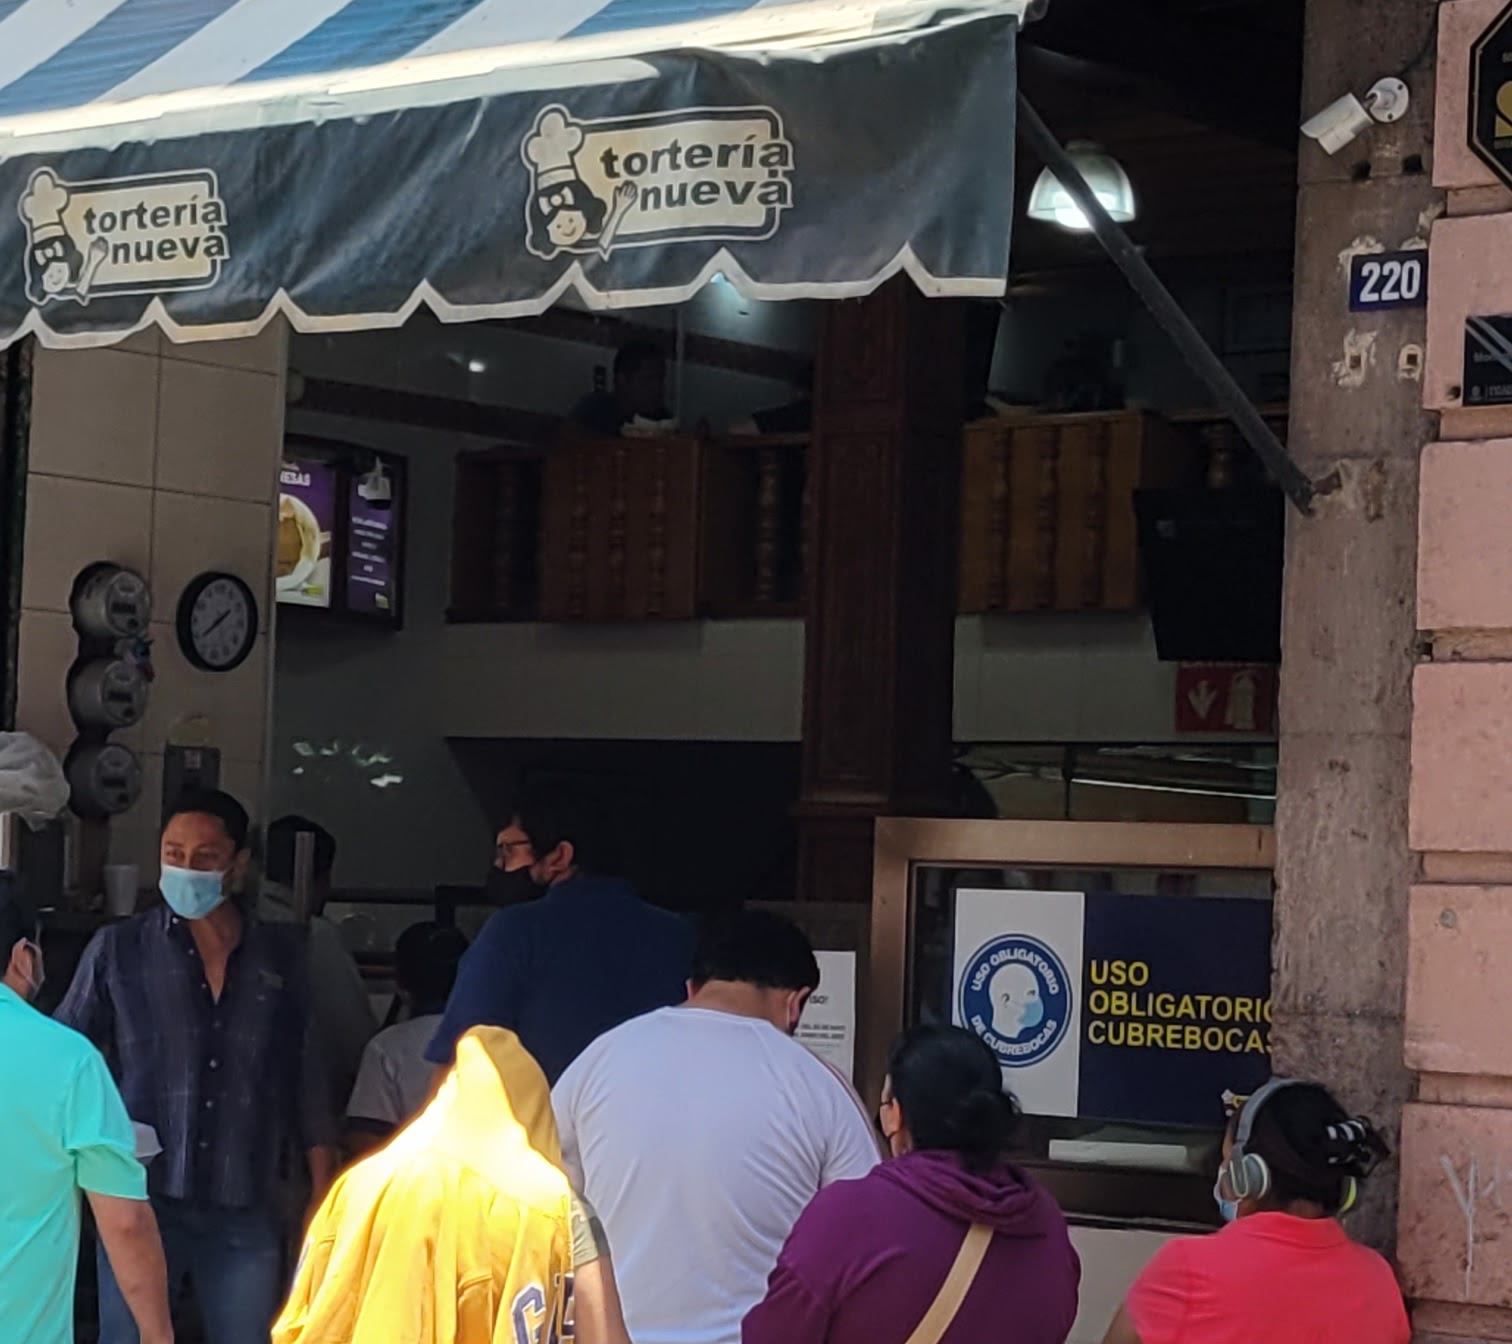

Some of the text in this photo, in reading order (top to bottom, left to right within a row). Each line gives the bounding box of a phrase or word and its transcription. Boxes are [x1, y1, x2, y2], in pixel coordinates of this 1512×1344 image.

[600, 134, 789, 179] tortería
[83, 194, 222, 235] tortería
[640, 179, 789, 211] nueva
[112, 234, 225, 265] nueva
[1359, 259, 1421, 302] 220
[971, 947, 1059, 995] USO OBLIGATORIO
[1090, 959, 1150, 987] USO
